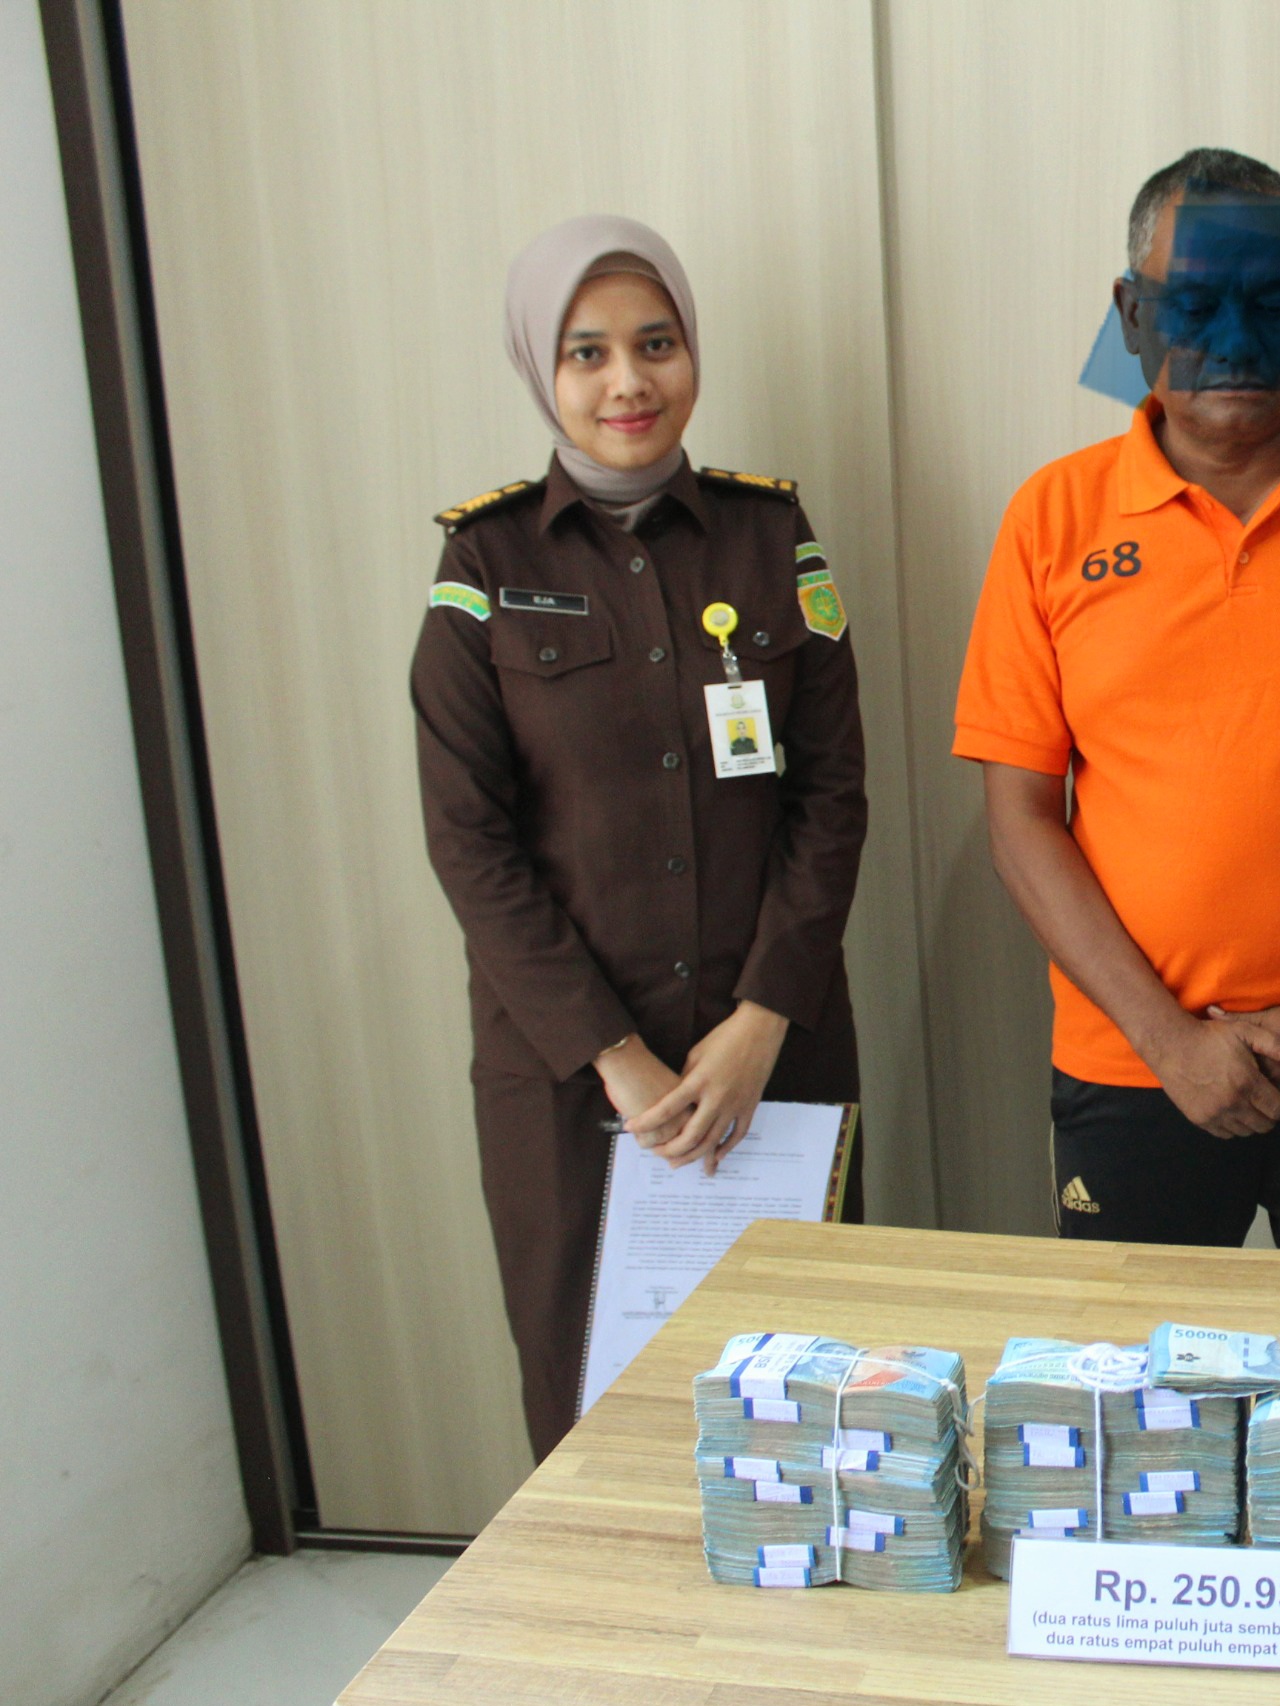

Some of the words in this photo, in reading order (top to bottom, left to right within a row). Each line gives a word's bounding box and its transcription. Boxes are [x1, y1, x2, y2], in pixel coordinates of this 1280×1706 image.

[1081, 540, 1142, 582] 68
[532, 595, 556, 606] EJA
[1174, 1328, 1229, 1342] 50000
[1095, 1569, 1156, 1612] Rp.
[1033, 1611, 1066, 1627] (dua
[1071, 1614, 1112, 1627] ratus
[1116, 1615, 1149, 1629] lima
[1154, 1617, 1199, 1633] puluh
[1202, 1619, 1233, 1636] juta
[1046, 1632, 1075, 1646] dua
[1080, 1635, 1120, 1648] ratus
[1124, 1638, 1174, 1653] empat
[1178, 1639, 1223, 1654] puluh
[1227, 1642, 1278, 1658] empat
